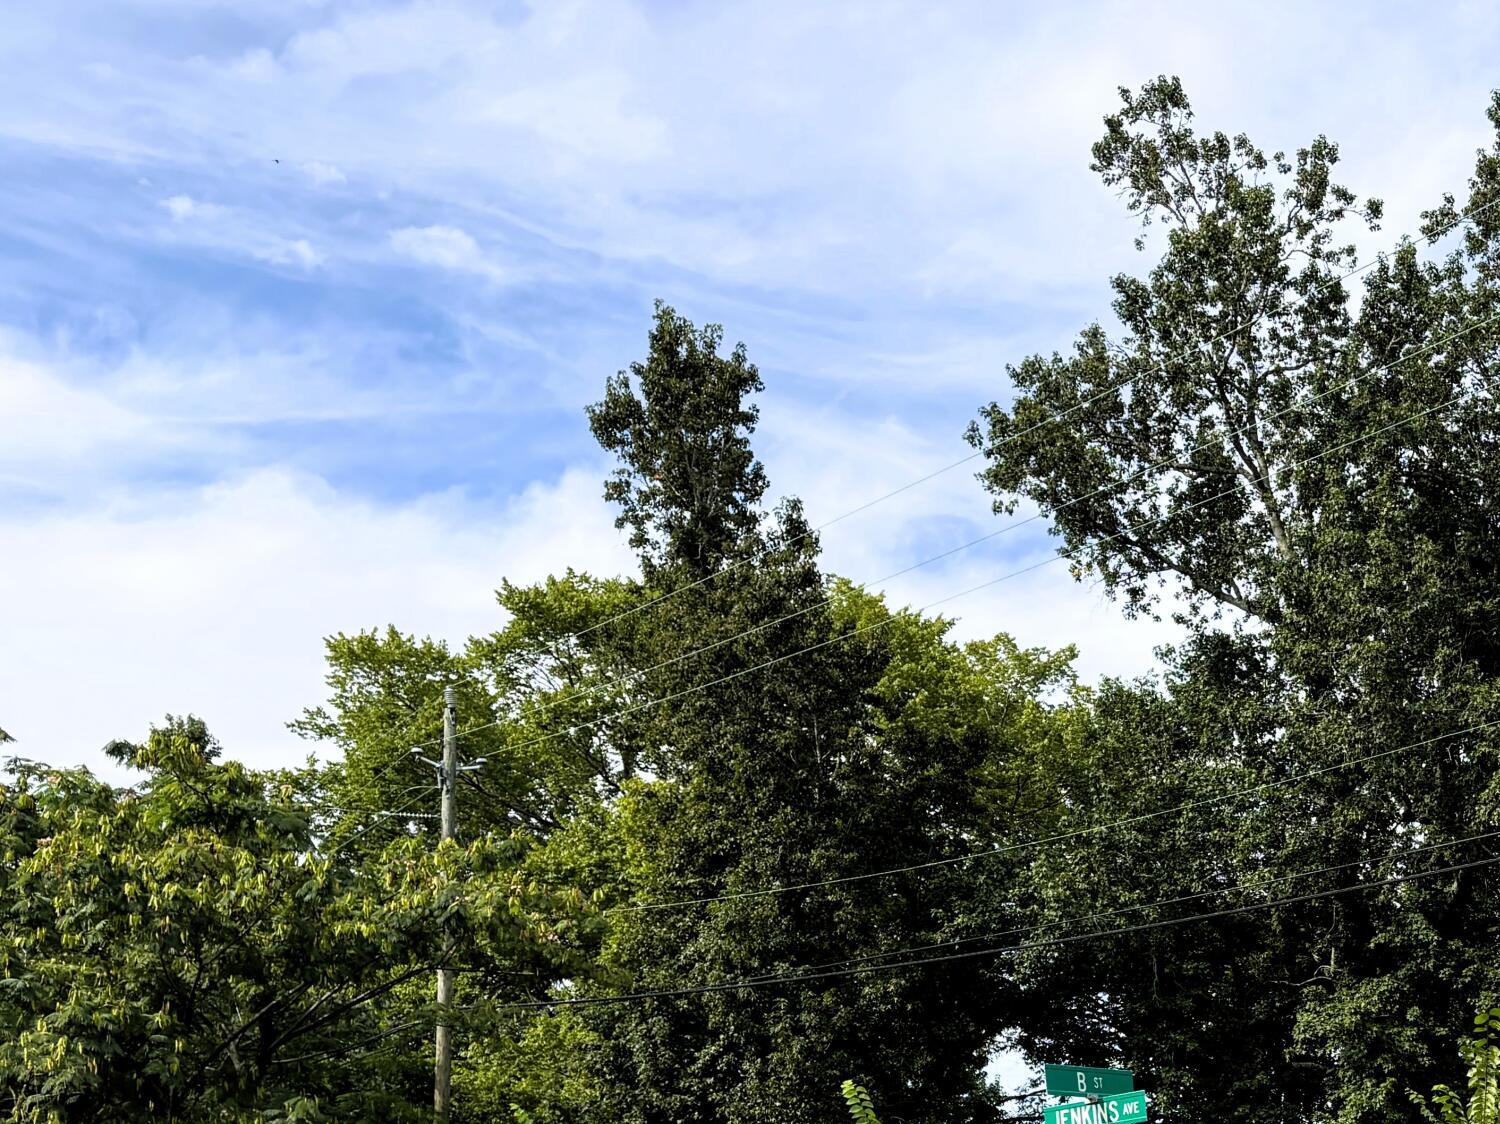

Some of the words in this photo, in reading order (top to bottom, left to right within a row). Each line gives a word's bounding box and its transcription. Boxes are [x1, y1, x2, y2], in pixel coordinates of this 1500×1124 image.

[1076, 1071, 1087, 1092] B
[1093, 1077, 1103, 1089] ST
[1122, 1101, 1139, 1116] AVE
